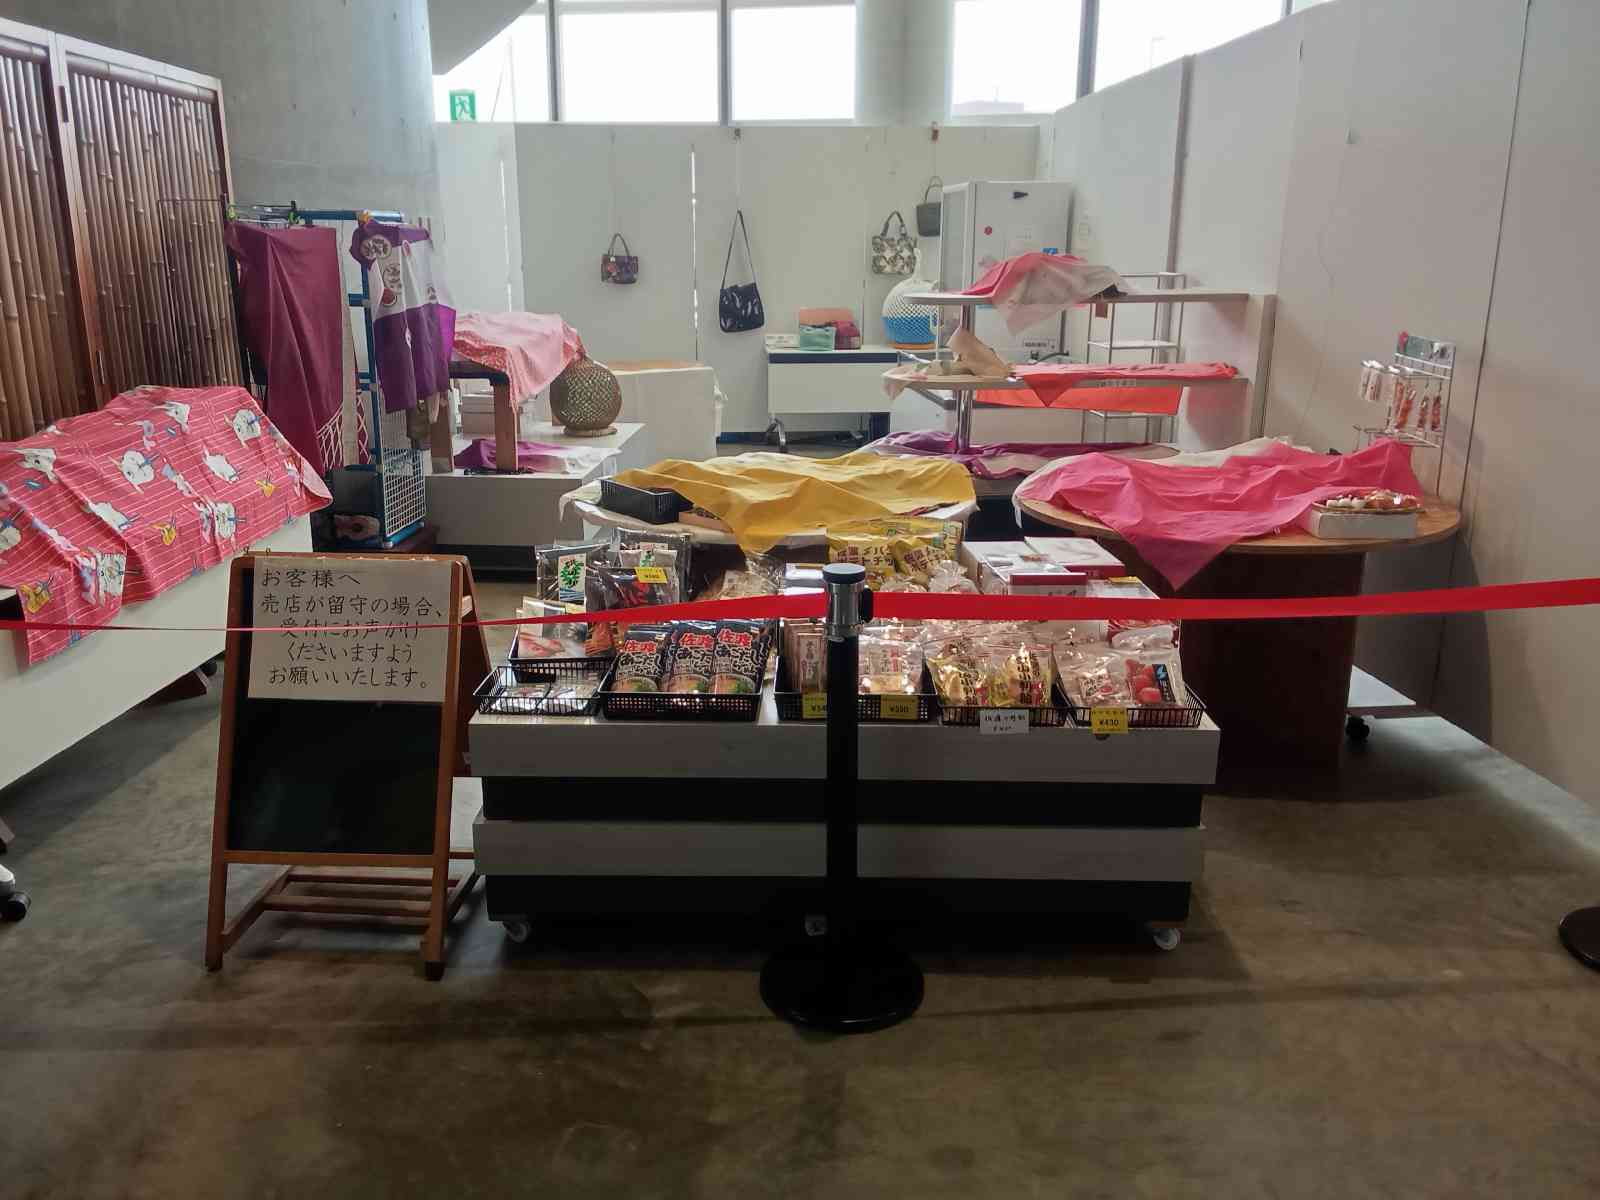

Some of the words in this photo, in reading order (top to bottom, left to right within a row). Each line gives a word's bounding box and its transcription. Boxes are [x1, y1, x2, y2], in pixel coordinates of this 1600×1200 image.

[261, 569, 362, 588] お客様へ
[261, 595, 443, 617] 売店が留守の場合、
[287, 643, 415, 663] くださいますよう
[269, 667, 429, 689] お願いいたします。
